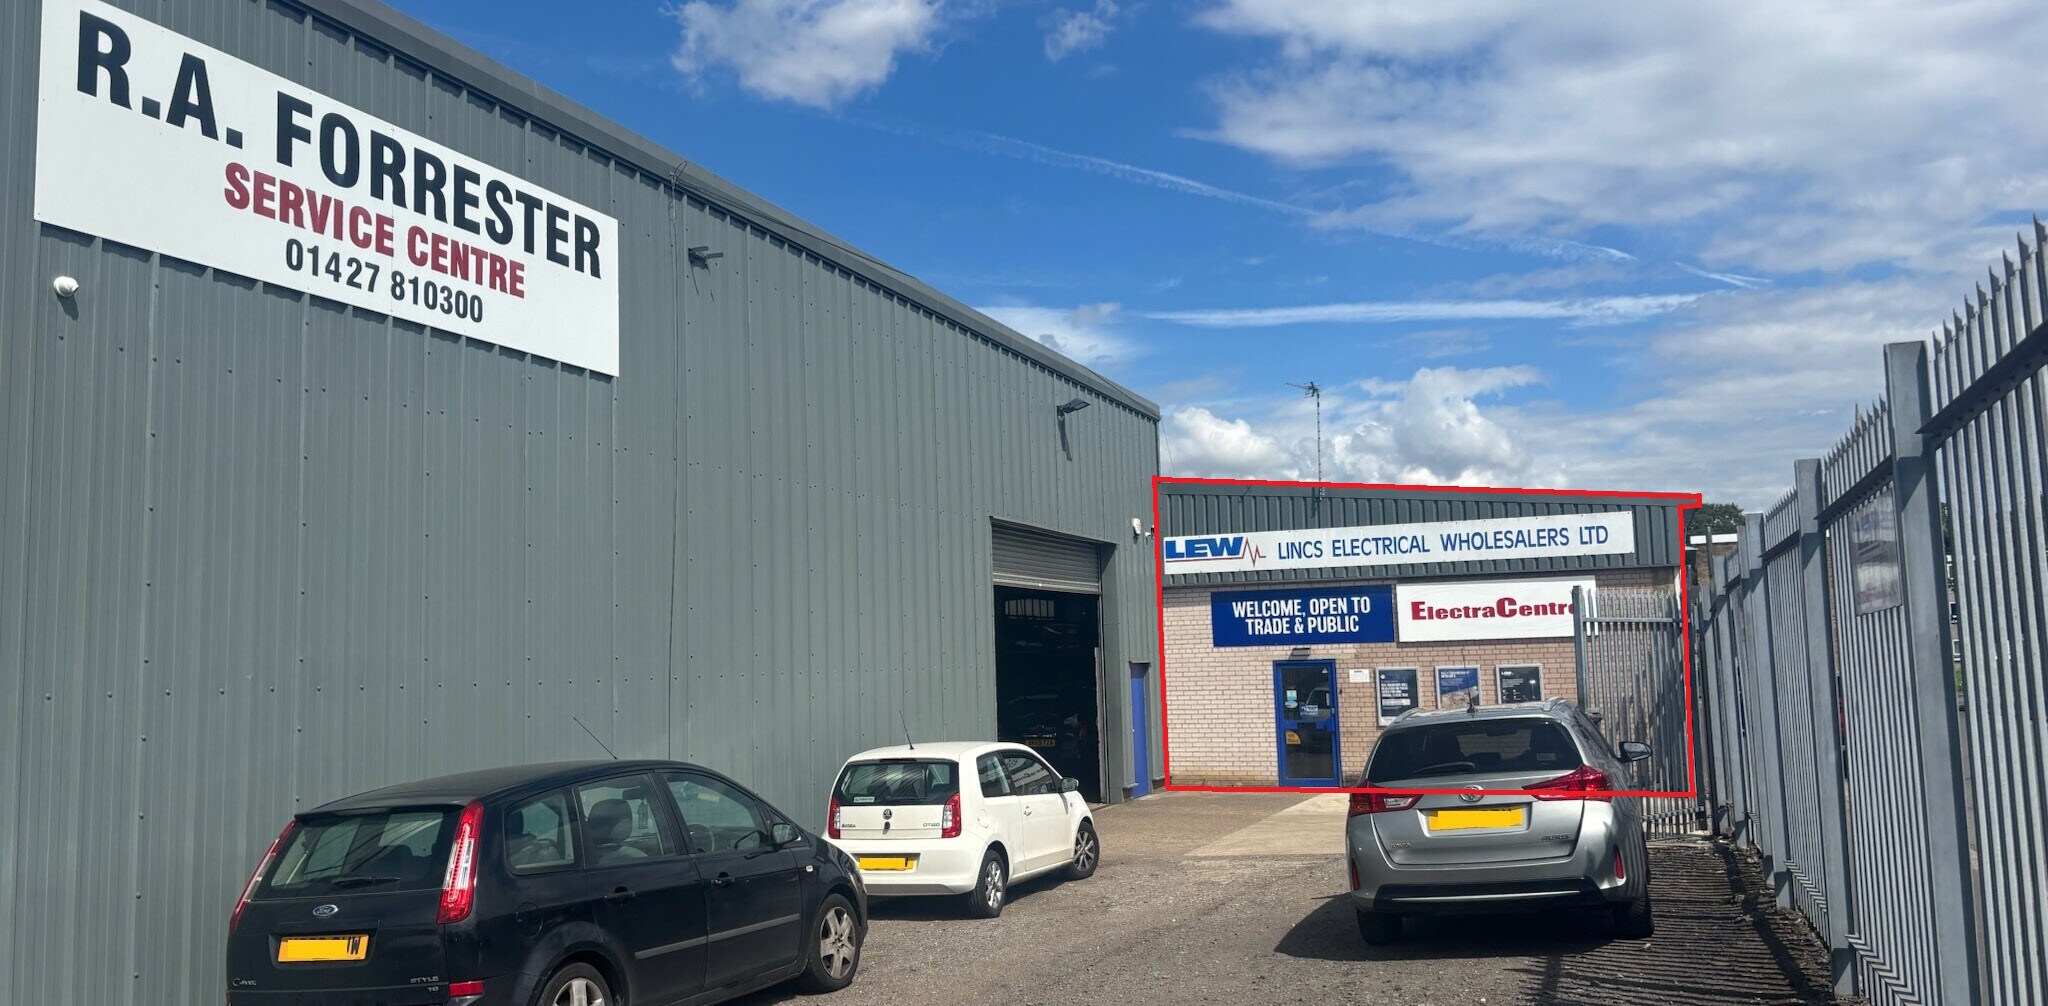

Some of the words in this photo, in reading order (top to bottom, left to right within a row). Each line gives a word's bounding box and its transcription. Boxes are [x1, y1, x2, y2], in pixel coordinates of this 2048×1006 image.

[77, 10, 243, 150] R.A.
[276, 90, 602, 279] FORRESTER
[224, 163, 394, 257] SERVICE
[407, 226, 525, 298] CENTRE
[286, 238, 380, 293] 01427
[390, 270, 483, 323] 810300
[1164, 536, 1244, 560] LEW
[1278, 540, 1323, 560] LINCS
[1332, 534, 1431, 558] ELECTRICAL
[1440, 527, 1570, 552] WHOLESALERS
[1579, 525, 1609, 545] LTD
[1231, 599, 1306, 618] WELCOME,
[1309, 597, 1348, 616] OPEN
[1350, 596, 1371, 614] TO
[1245, 617, 1291, 636] TRADE
[1294, 616, 1304, 634] &
[1307, 615, 1360, 634] PUBLIC
[410, 975, 439, 984] STYLE
